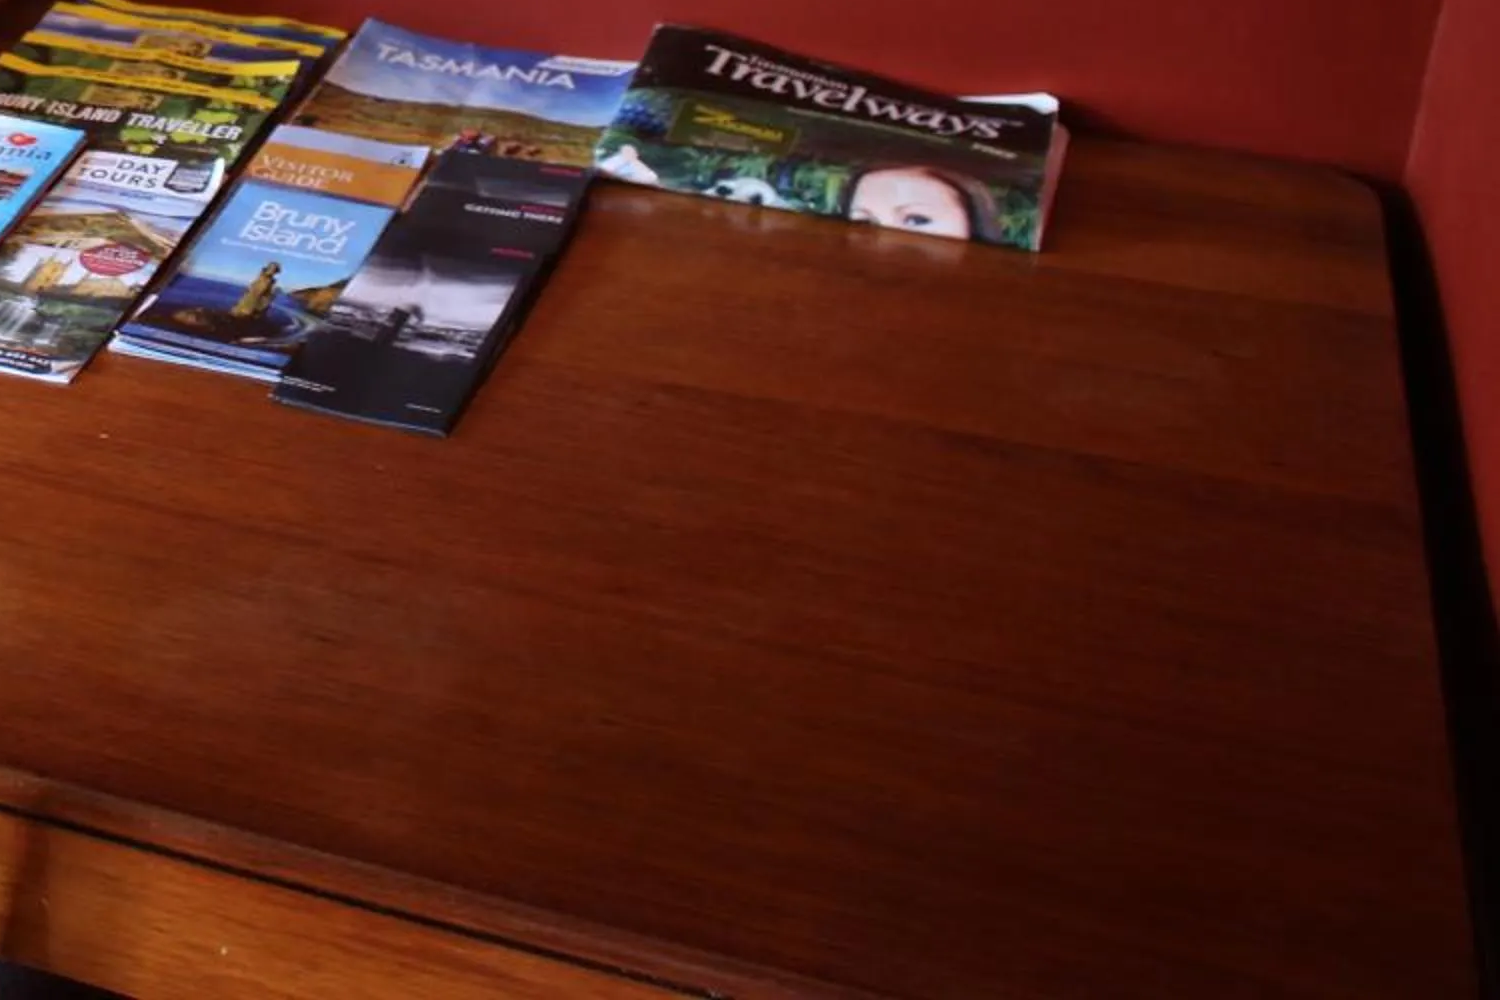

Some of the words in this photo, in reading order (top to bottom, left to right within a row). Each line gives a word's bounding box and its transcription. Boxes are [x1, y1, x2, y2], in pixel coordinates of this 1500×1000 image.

[377, 43, 575, 89] TASMANIA
[704, 44, 1008, 139] Travelways
[45, 100, 122, 123] ISLAND
[126, 112, 244, 141] TRAVELLER
[78, 167, 158, 189] TOURS
[116, 159, 167, 175] DAY
[262, 154, 355, 183] VISITOR
[254, 200, 356, 237] Bruny
[239, 219, 349, 255] Island
